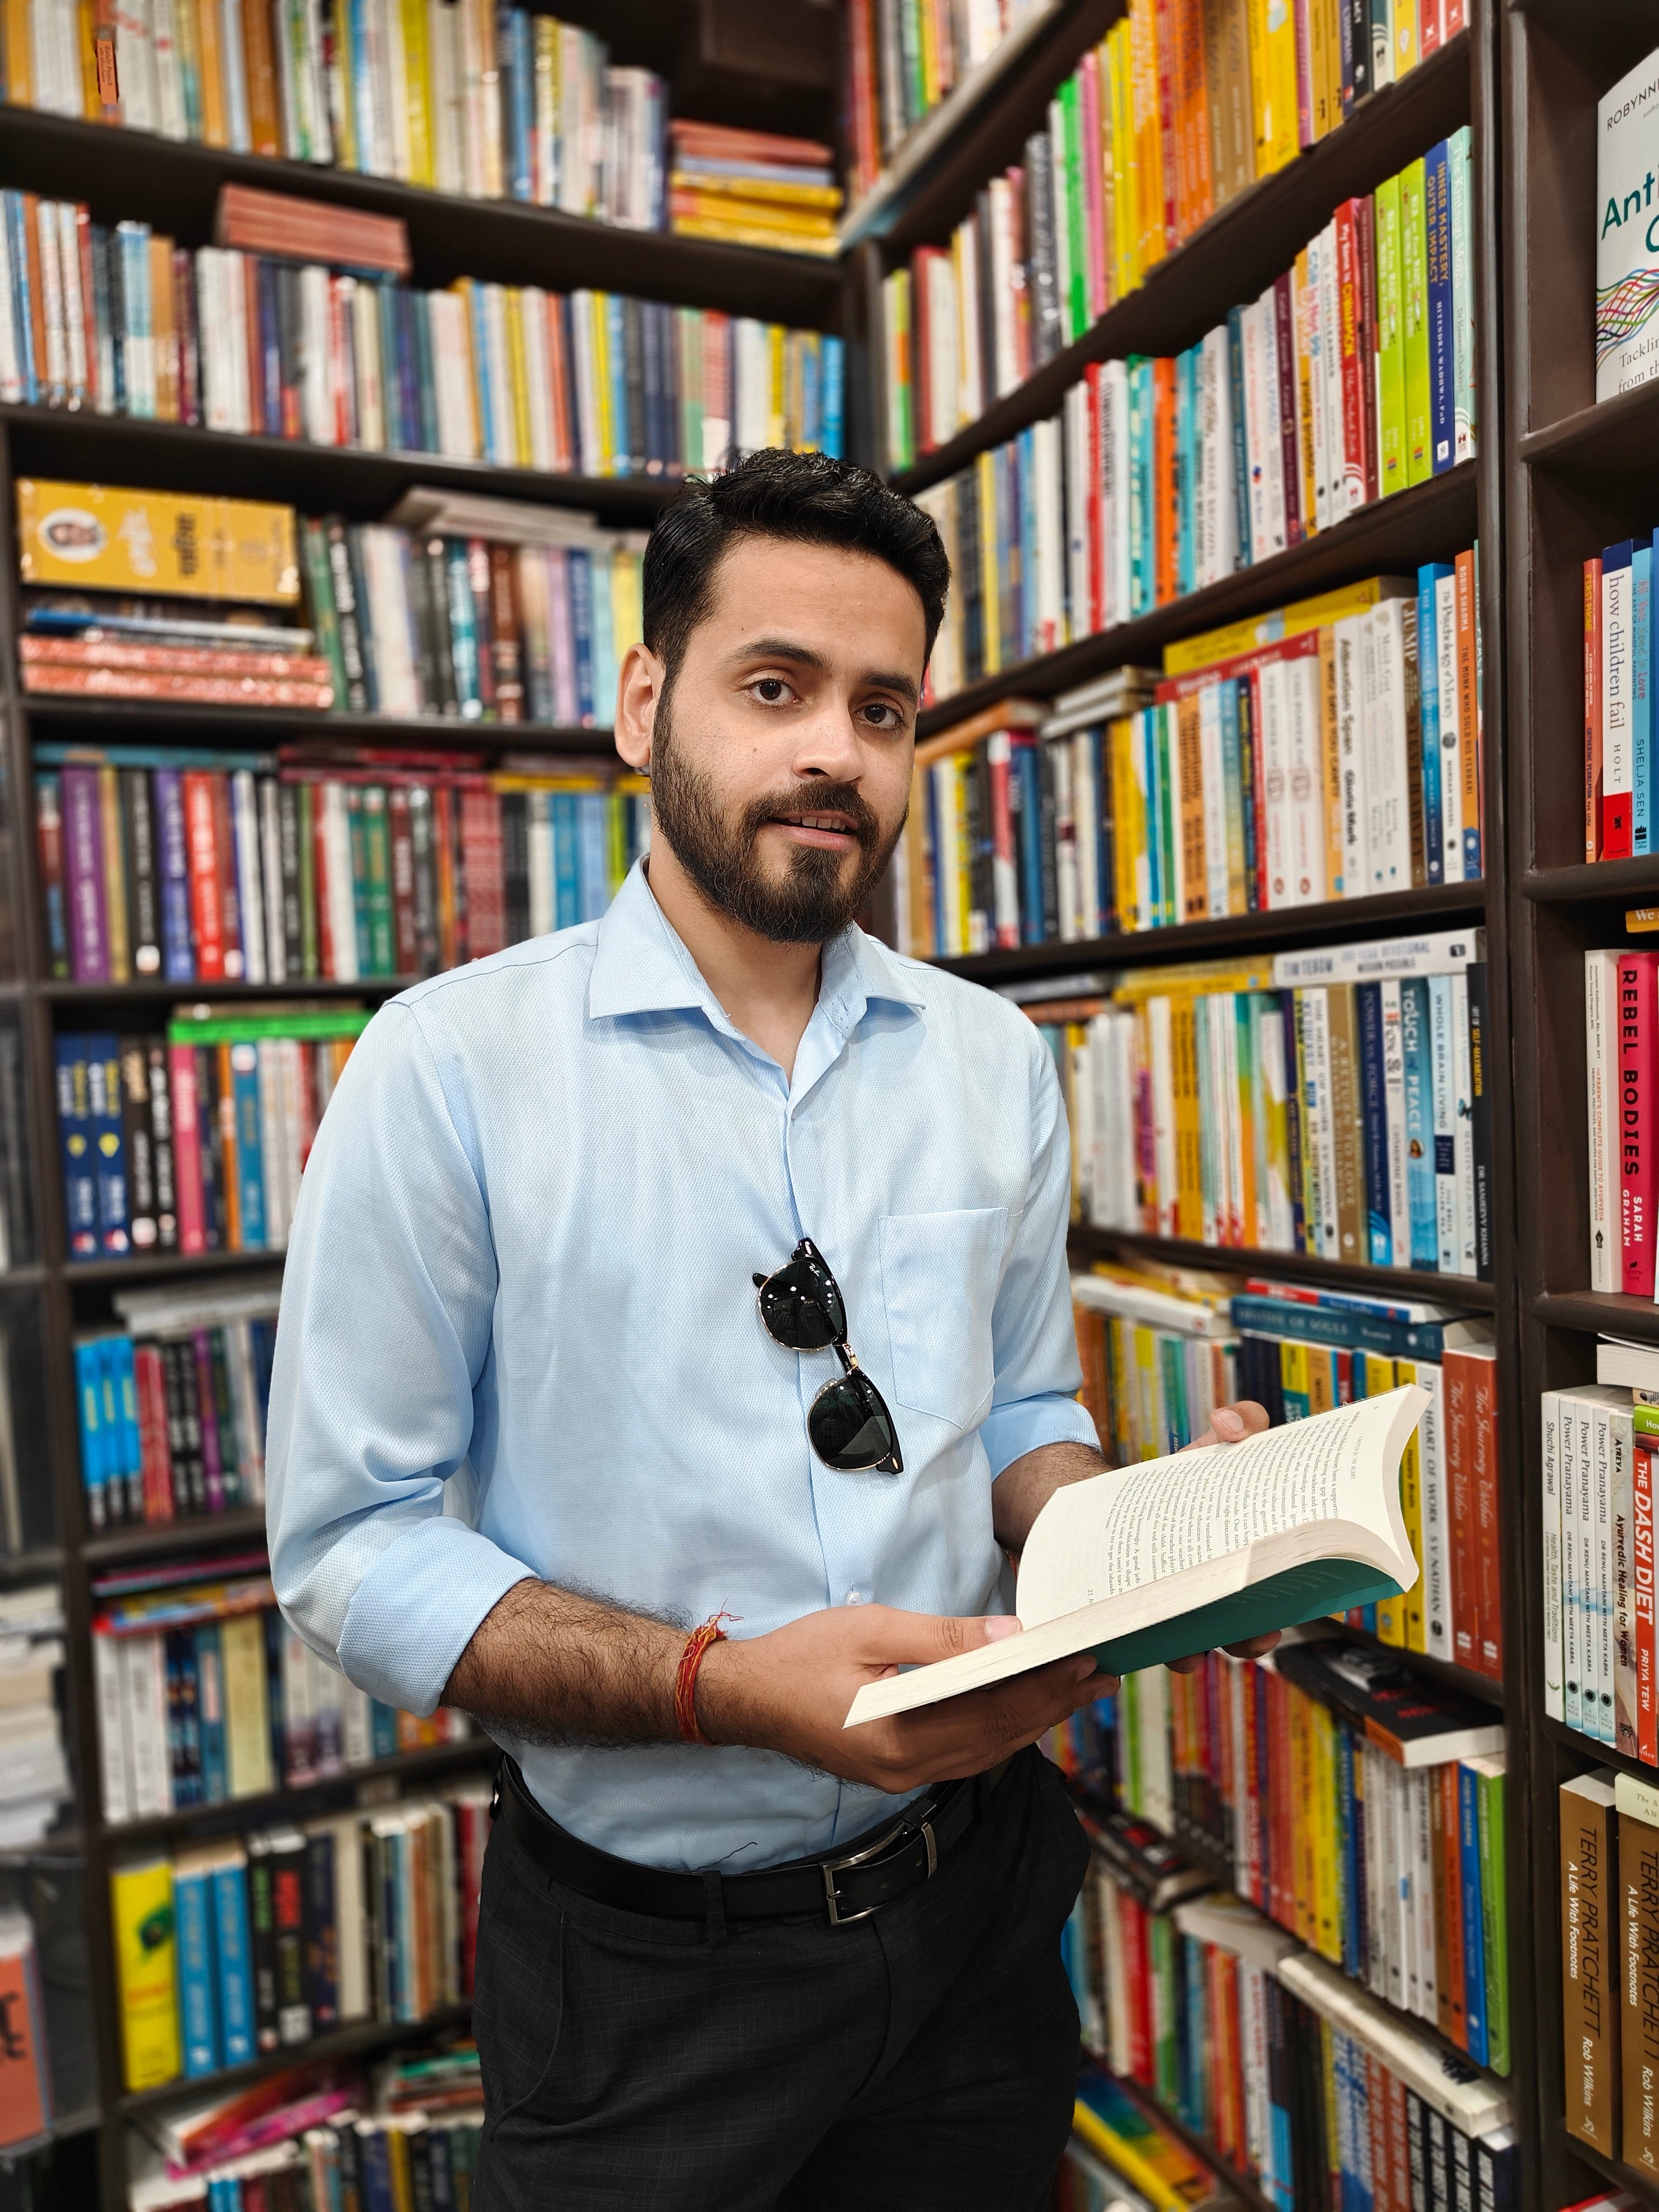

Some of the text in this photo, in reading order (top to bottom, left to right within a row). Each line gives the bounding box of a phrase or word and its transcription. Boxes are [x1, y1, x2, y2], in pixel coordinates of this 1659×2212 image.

[1437, 161, 1448, 287] INNER MASTERY,
[1453, 143, 1463, 238] The Kintsugi
[1601, 162, 1659, 241] Ant
[1427, 176, 1438, 284] OUTER IMPACT
[1342, 284, 1354, 357] CINNAMON
[1457, 307, 1462, 319] Dr
[1459, 565, 1468, 632] ROBIN SHARMA
[1632, 615, 1636, 624] OF
[1403, 609, 1417, 662] JUMP
[1440, 605, 1453, 669] Psychology
[1610, 575, 1624, 730] how children fail
[1638, 580, 1649, 699] All You Need is Love
[1443, 679, 1454, 718] Money
[1636, 739, 1644, 787] SHELJA
[1435, 994, 1444, 1039] WHOLE
[1472, 1028, 1482, 1096] SELF-MAXIMIZATION
[1623, 969, 1640, 1176] REBEL BODIES
[1407, 1075, 1420, 1131] PEACE
[1438, 1088, 1447, 1129] LIVING
[1478, 1182, 1486, 1226] SANJEEVV
[1599, 1173, 1603, 1182] TO
[1633, 1196, 1642, 1242] SARAH
[1448, 1379, 1467, 1521] The Journey Within
[1474, 1385, 1493, 1528] The Journey Within
[1545, 1421, 1555, 1495] Shuchi Agrawal
[1563, 1416, 1573, 1515] Power Pranayama
[1580, 1421, 1590, 1521] Power Pranayama
[1597, 1422, 1607, 1523] Power Pranayama
[1260, 1510, 1268, 1533] greatest
[1425, 1410, 1441, 1614] HEART OF WORK NATHAN
[1567, 1531, 1572, 1541] DR
[1583, 1537, 1589, 1548] DR
[1601, 1540, 1606, 1550] DR
[1634, 1461, 1653, 1625] THE DASH DIET
[1124, 1569, 1132, 1587] shape
[1615, 1514, 1629, 1667] Ayurvedic Healing for Women
[1640, 1648, 1650, 1711] PRIYA TEW
[1636, 1793, 1649, 1803] The
[1568, 1861, 1580, 1979] A Life With Footnotes
[1580, 1827, 1600, 2039] TERRY PRATCHETT
[1628, 1885, 1639, 2006] A Life With Footnotes
[1641, 1851, 1659, 2060] TERRY PRATCHETT
[1582, 2036, 1594, 2107] Rob Wilkins
[1642, 2066, 1654, 2137] Rob Wilkins
